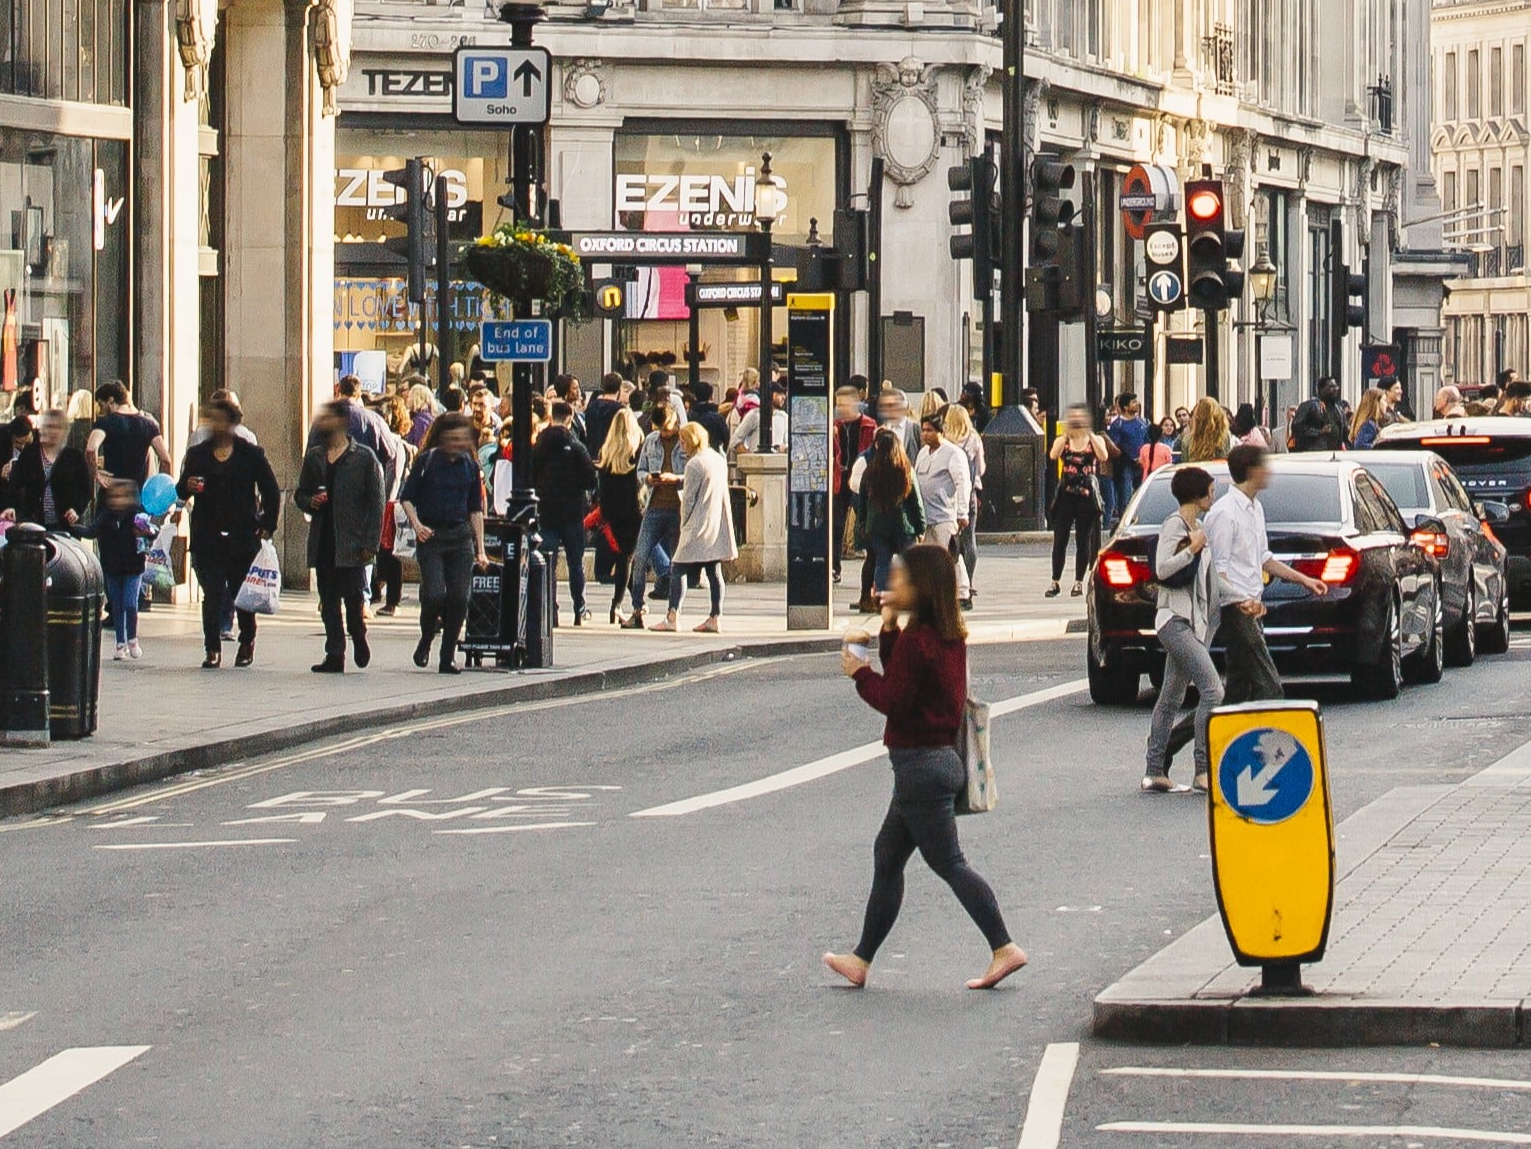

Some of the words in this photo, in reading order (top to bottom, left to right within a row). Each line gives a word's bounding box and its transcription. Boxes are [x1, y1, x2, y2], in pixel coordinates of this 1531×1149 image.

[472, 60, 500, 95] P
[486, 104, 517, 115] Soho
[679, 211, 788, 226] underwr
[580, 238, 634, 252] OXFORD
[636, 238, 682, 252] CIRCUS
[682, 239, 738, 253] STATION
[699, 288, 726, 299] OXFORD
[494, 327, 519, 339] End
[524, 327, 538, 339] of
[487, 342, 511, 354] bus
[515, 342, 544, 354] lane
[1100, 339, 1142, 350] KIKO
[472, 576, 500, 589] FREE
[247, 786, 623, 808] BUS
